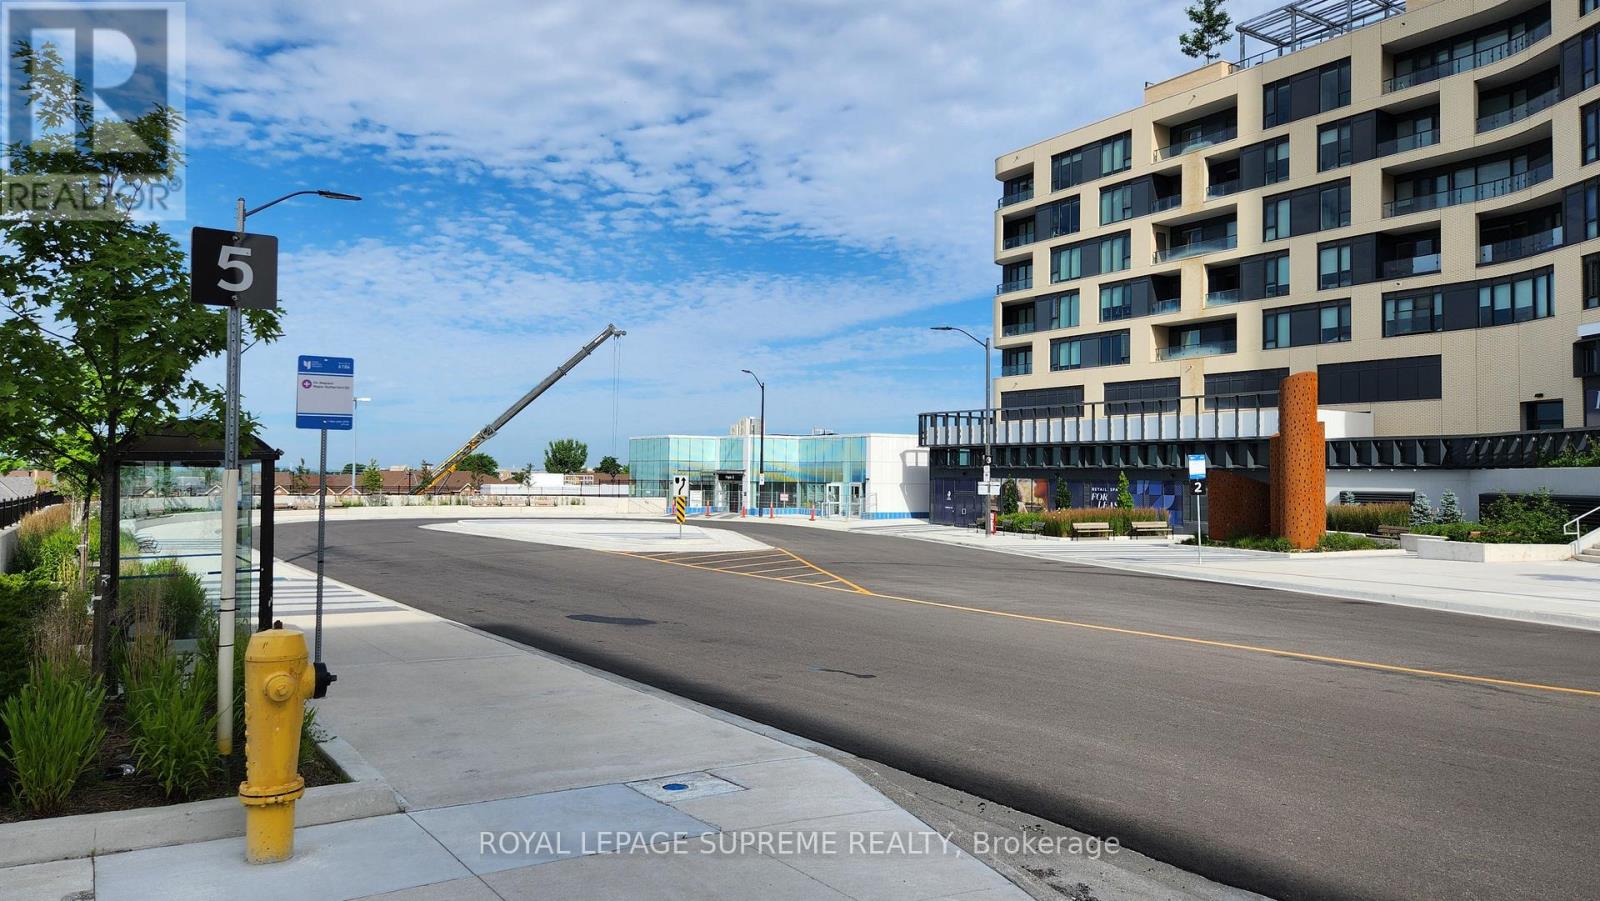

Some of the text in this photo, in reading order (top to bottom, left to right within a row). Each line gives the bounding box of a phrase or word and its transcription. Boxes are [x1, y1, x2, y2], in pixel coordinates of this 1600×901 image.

[217, 246, 254, 292] 5
[1194, 482, 1203, 493] 2
[1091, 492, 1108, 501] FOR
